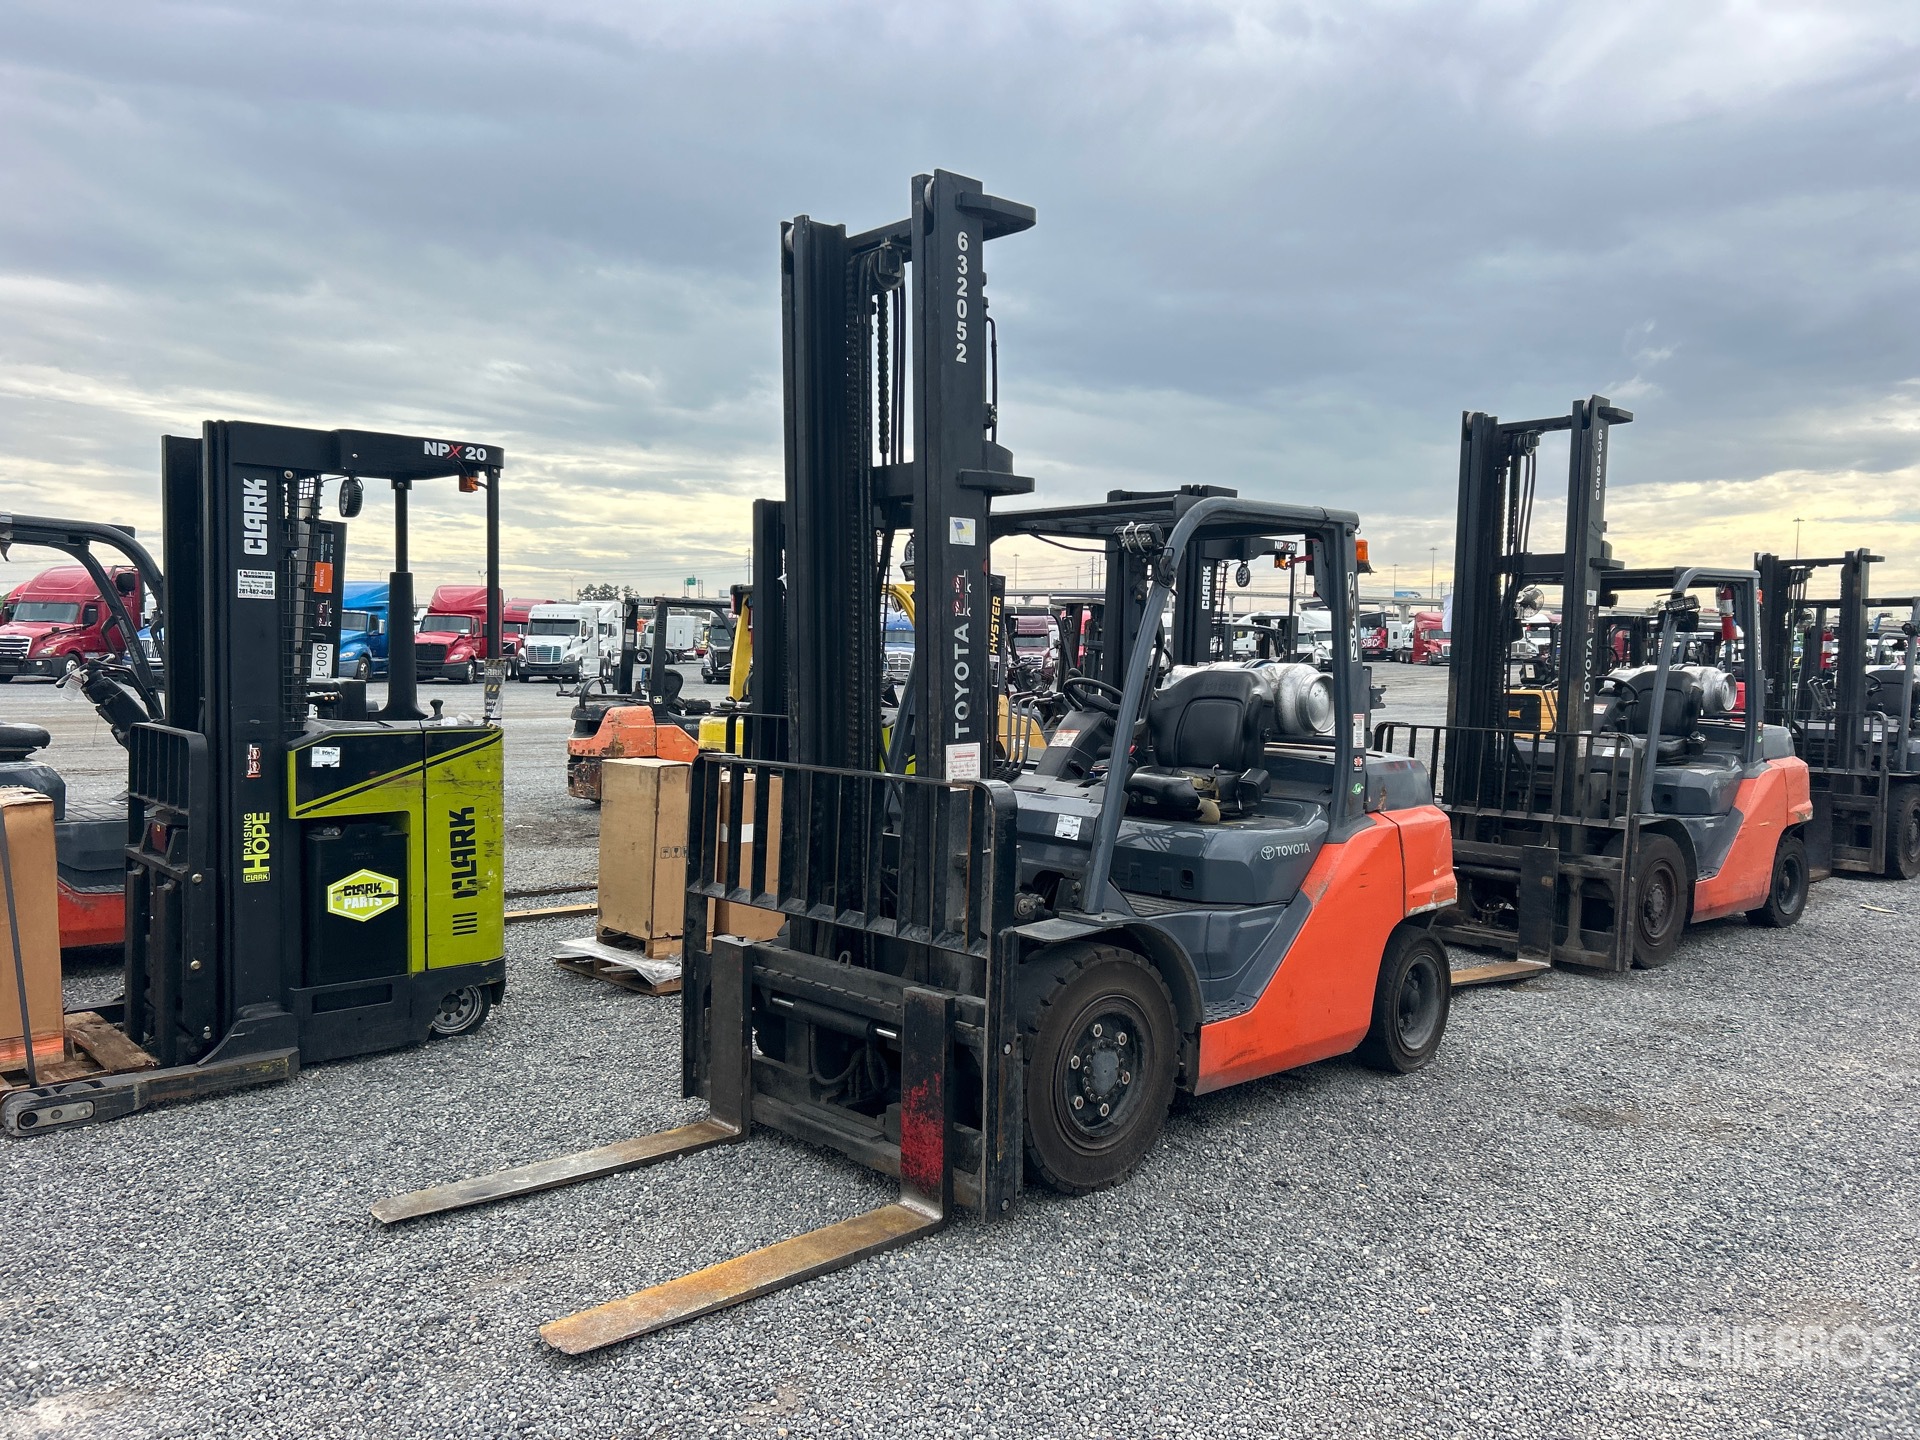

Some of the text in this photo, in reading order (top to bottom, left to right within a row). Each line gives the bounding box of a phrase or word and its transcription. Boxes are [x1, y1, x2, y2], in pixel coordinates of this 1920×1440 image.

[956, 231, 968, 363] 632052
[424, 441, 487, 461] NPX 20
[1595, 429, 1603, 500] 631950
[243, 478, 268, 555] CLARK
[1274, 541, 1296, 551] NPX 20
[1201, 566, 1211, 610] CLARK
[990, 596, 1001, 654] HYSTER
[954, 622, 970, 740] TOYOTA
[1583, 638, 1593, 703] TOYOTA
[243, 813, 252, 854] RAISING
[243, 812, 270, 873] HOPE
[449, 806, 477, 899] CLARK
[1276, 843, 1311, 856] TOYOTA
[245, 873, 268, 882] CLARK
[343, 882, 382, 896] CLARK
[344, 896, 383, 910] PARTS
